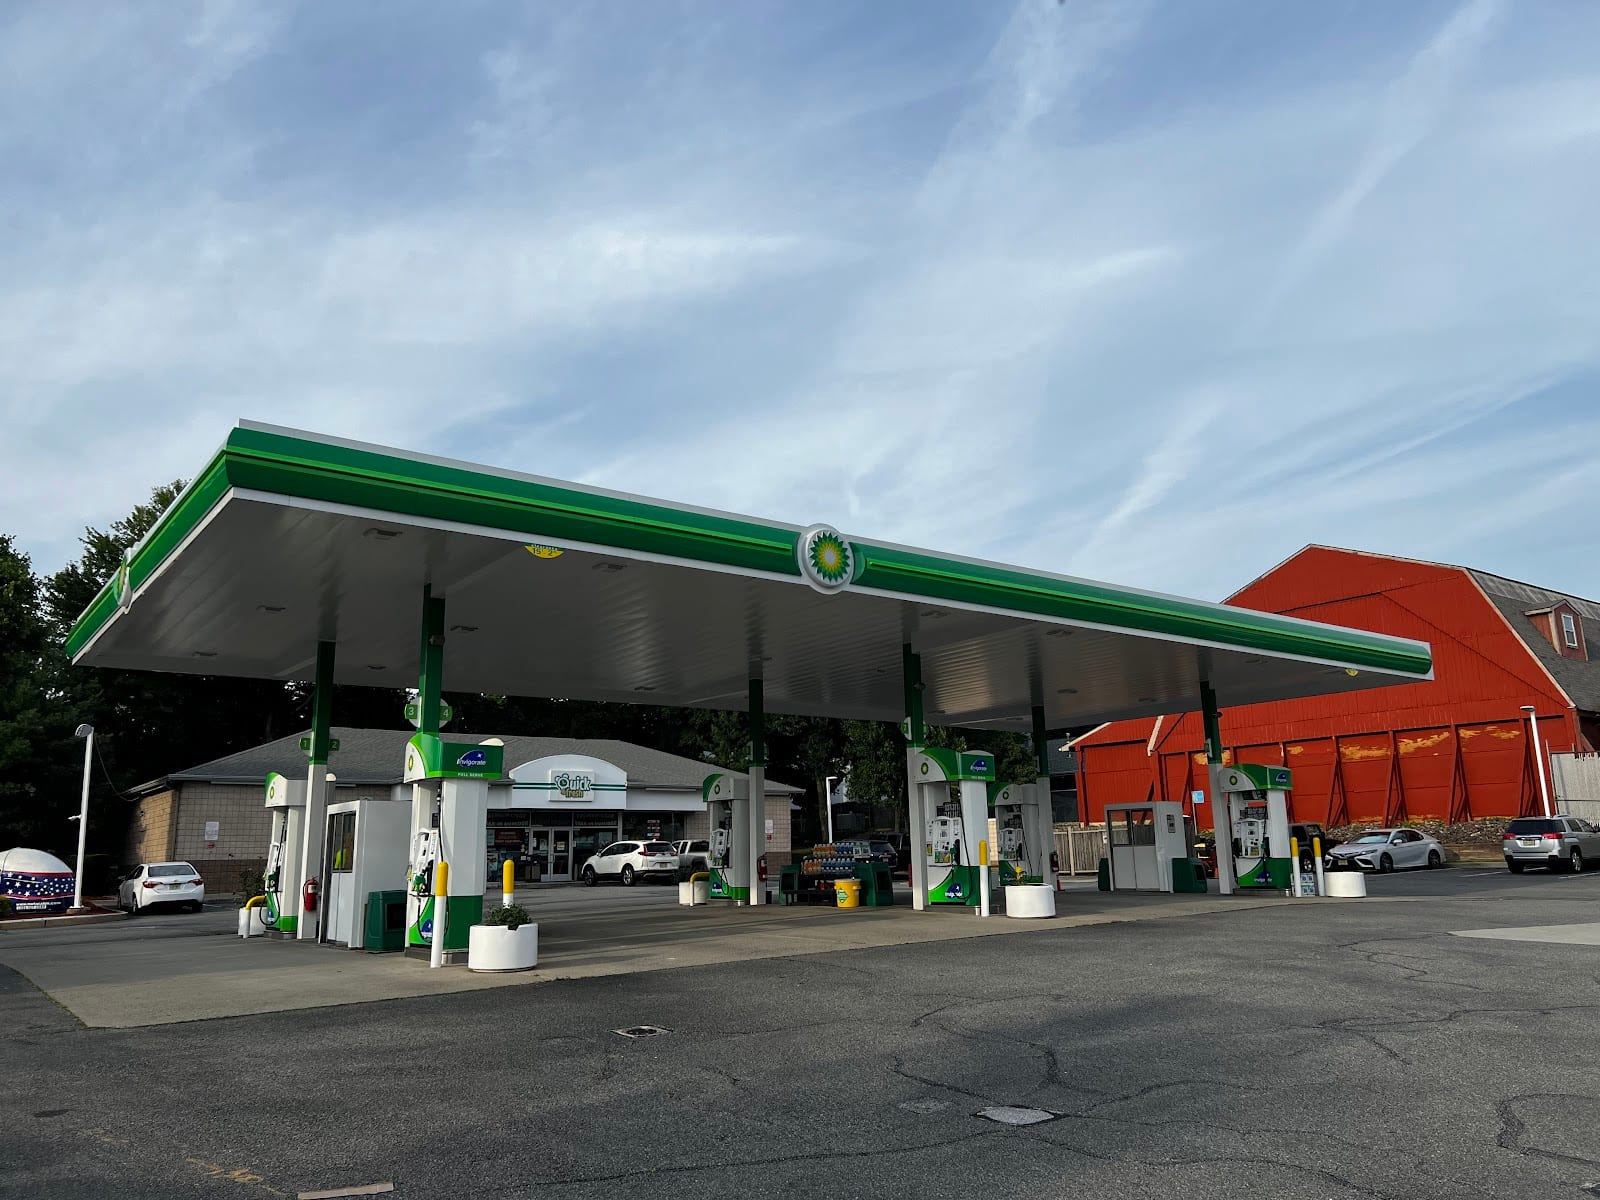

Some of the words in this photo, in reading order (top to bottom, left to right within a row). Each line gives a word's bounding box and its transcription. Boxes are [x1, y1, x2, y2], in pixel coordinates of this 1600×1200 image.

[408, 706, 415, 716] 3
[443, 708, 449, 718] 4
[303, 739, 308, 747] 1
[331, 741, 337, 749] 2
[456, 758, 487, 767] Invigorate
[555, 773, 592, 792] Quick
[565, 789, 584, 798] fresh
